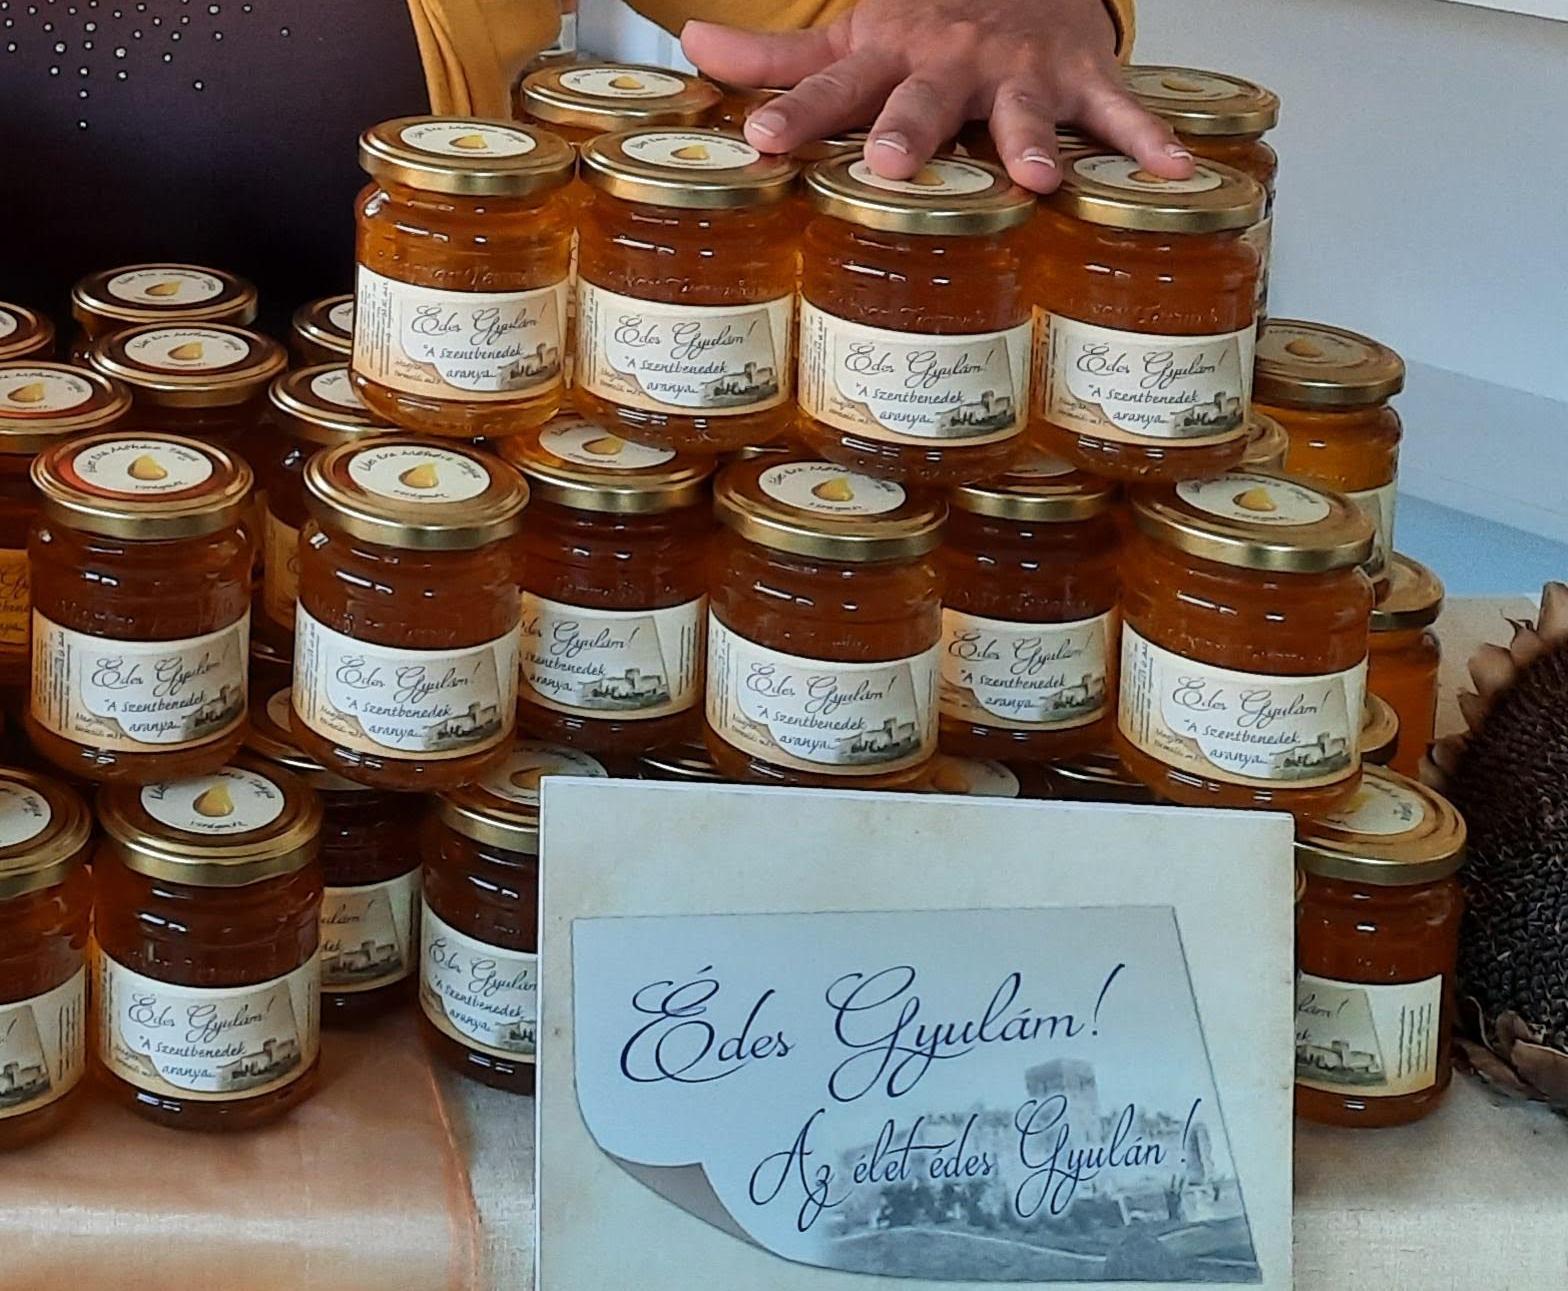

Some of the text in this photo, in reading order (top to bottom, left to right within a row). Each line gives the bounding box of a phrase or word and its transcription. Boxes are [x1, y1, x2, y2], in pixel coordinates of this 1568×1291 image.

[550, 620, 640, 658] Gyulám!
[620, 963, 1126, 1102] Édes Gyulám!
[749, 1109, 853, 1232] Az
[853, 1117, 957, 1185] élet
[929, 1114, 994, 1180] édes
